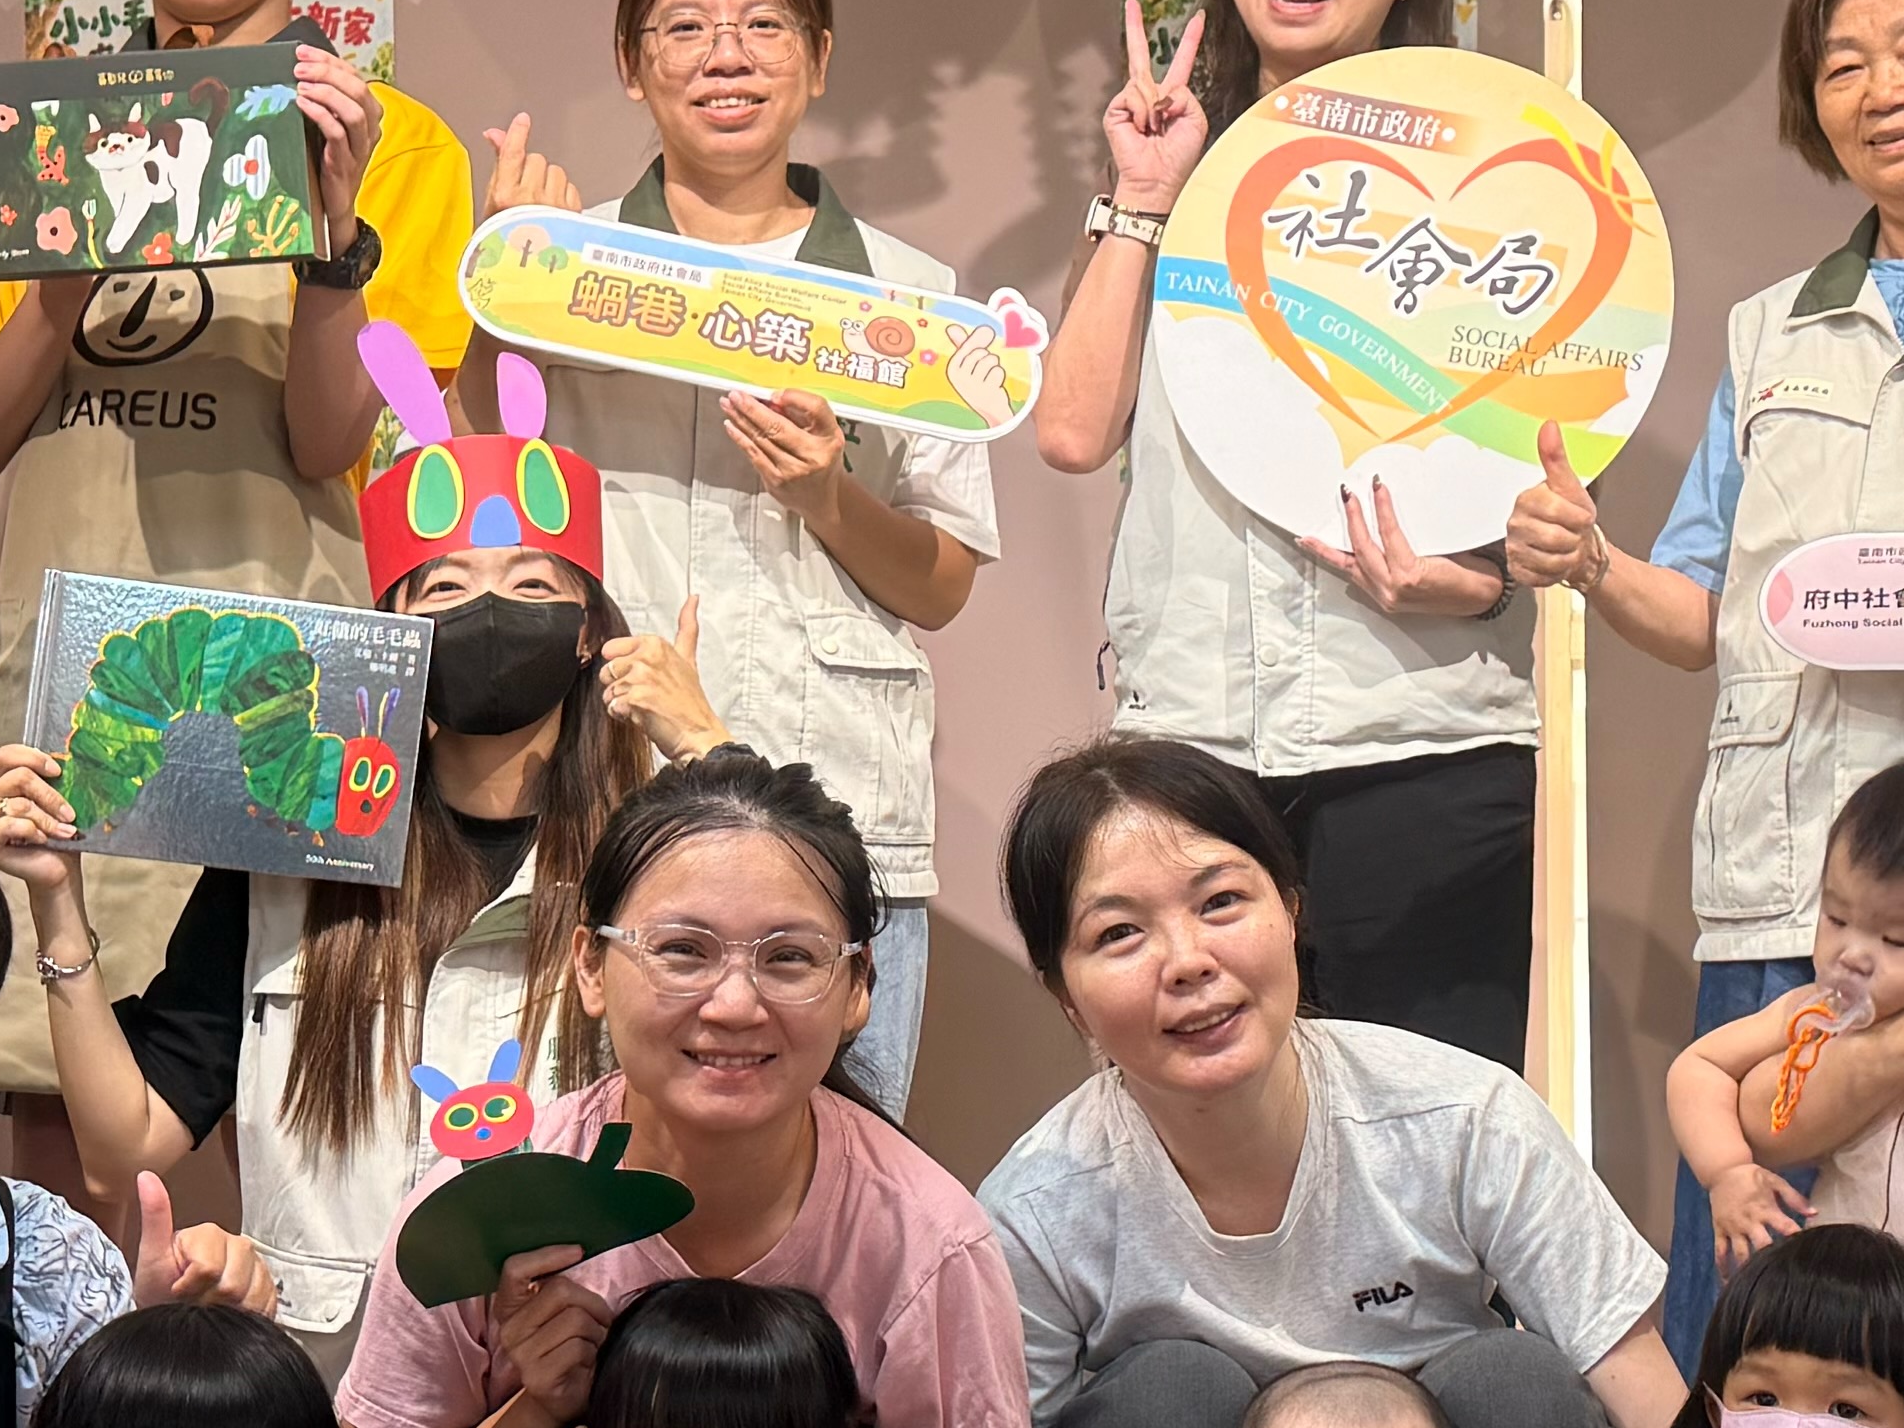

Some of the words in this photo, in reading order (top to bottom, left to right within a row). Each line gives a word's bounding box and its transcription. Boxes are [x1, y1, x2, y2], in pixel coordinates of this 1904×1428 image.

[1289, 92, 1442, 147] 臺南市政府
[1267, 169, 1559, 315] 社會局
[1166, 272, 1251, 301] TAINAN
[1260, 291, 1312, 321] CITY
[1318, 314, 1453, 415] GOVERNMENT
[1448, 346, 1546, 377] BUREAU
[1452, 325, 1537, 354] SOCIAL
[1544, 341, 1644, 371] AFFAIRS
[814, 347, 914, 389] 社福館
[1863, 617, 1903, 628] Social
[1352, 1281, 1414, 1312] FILA
